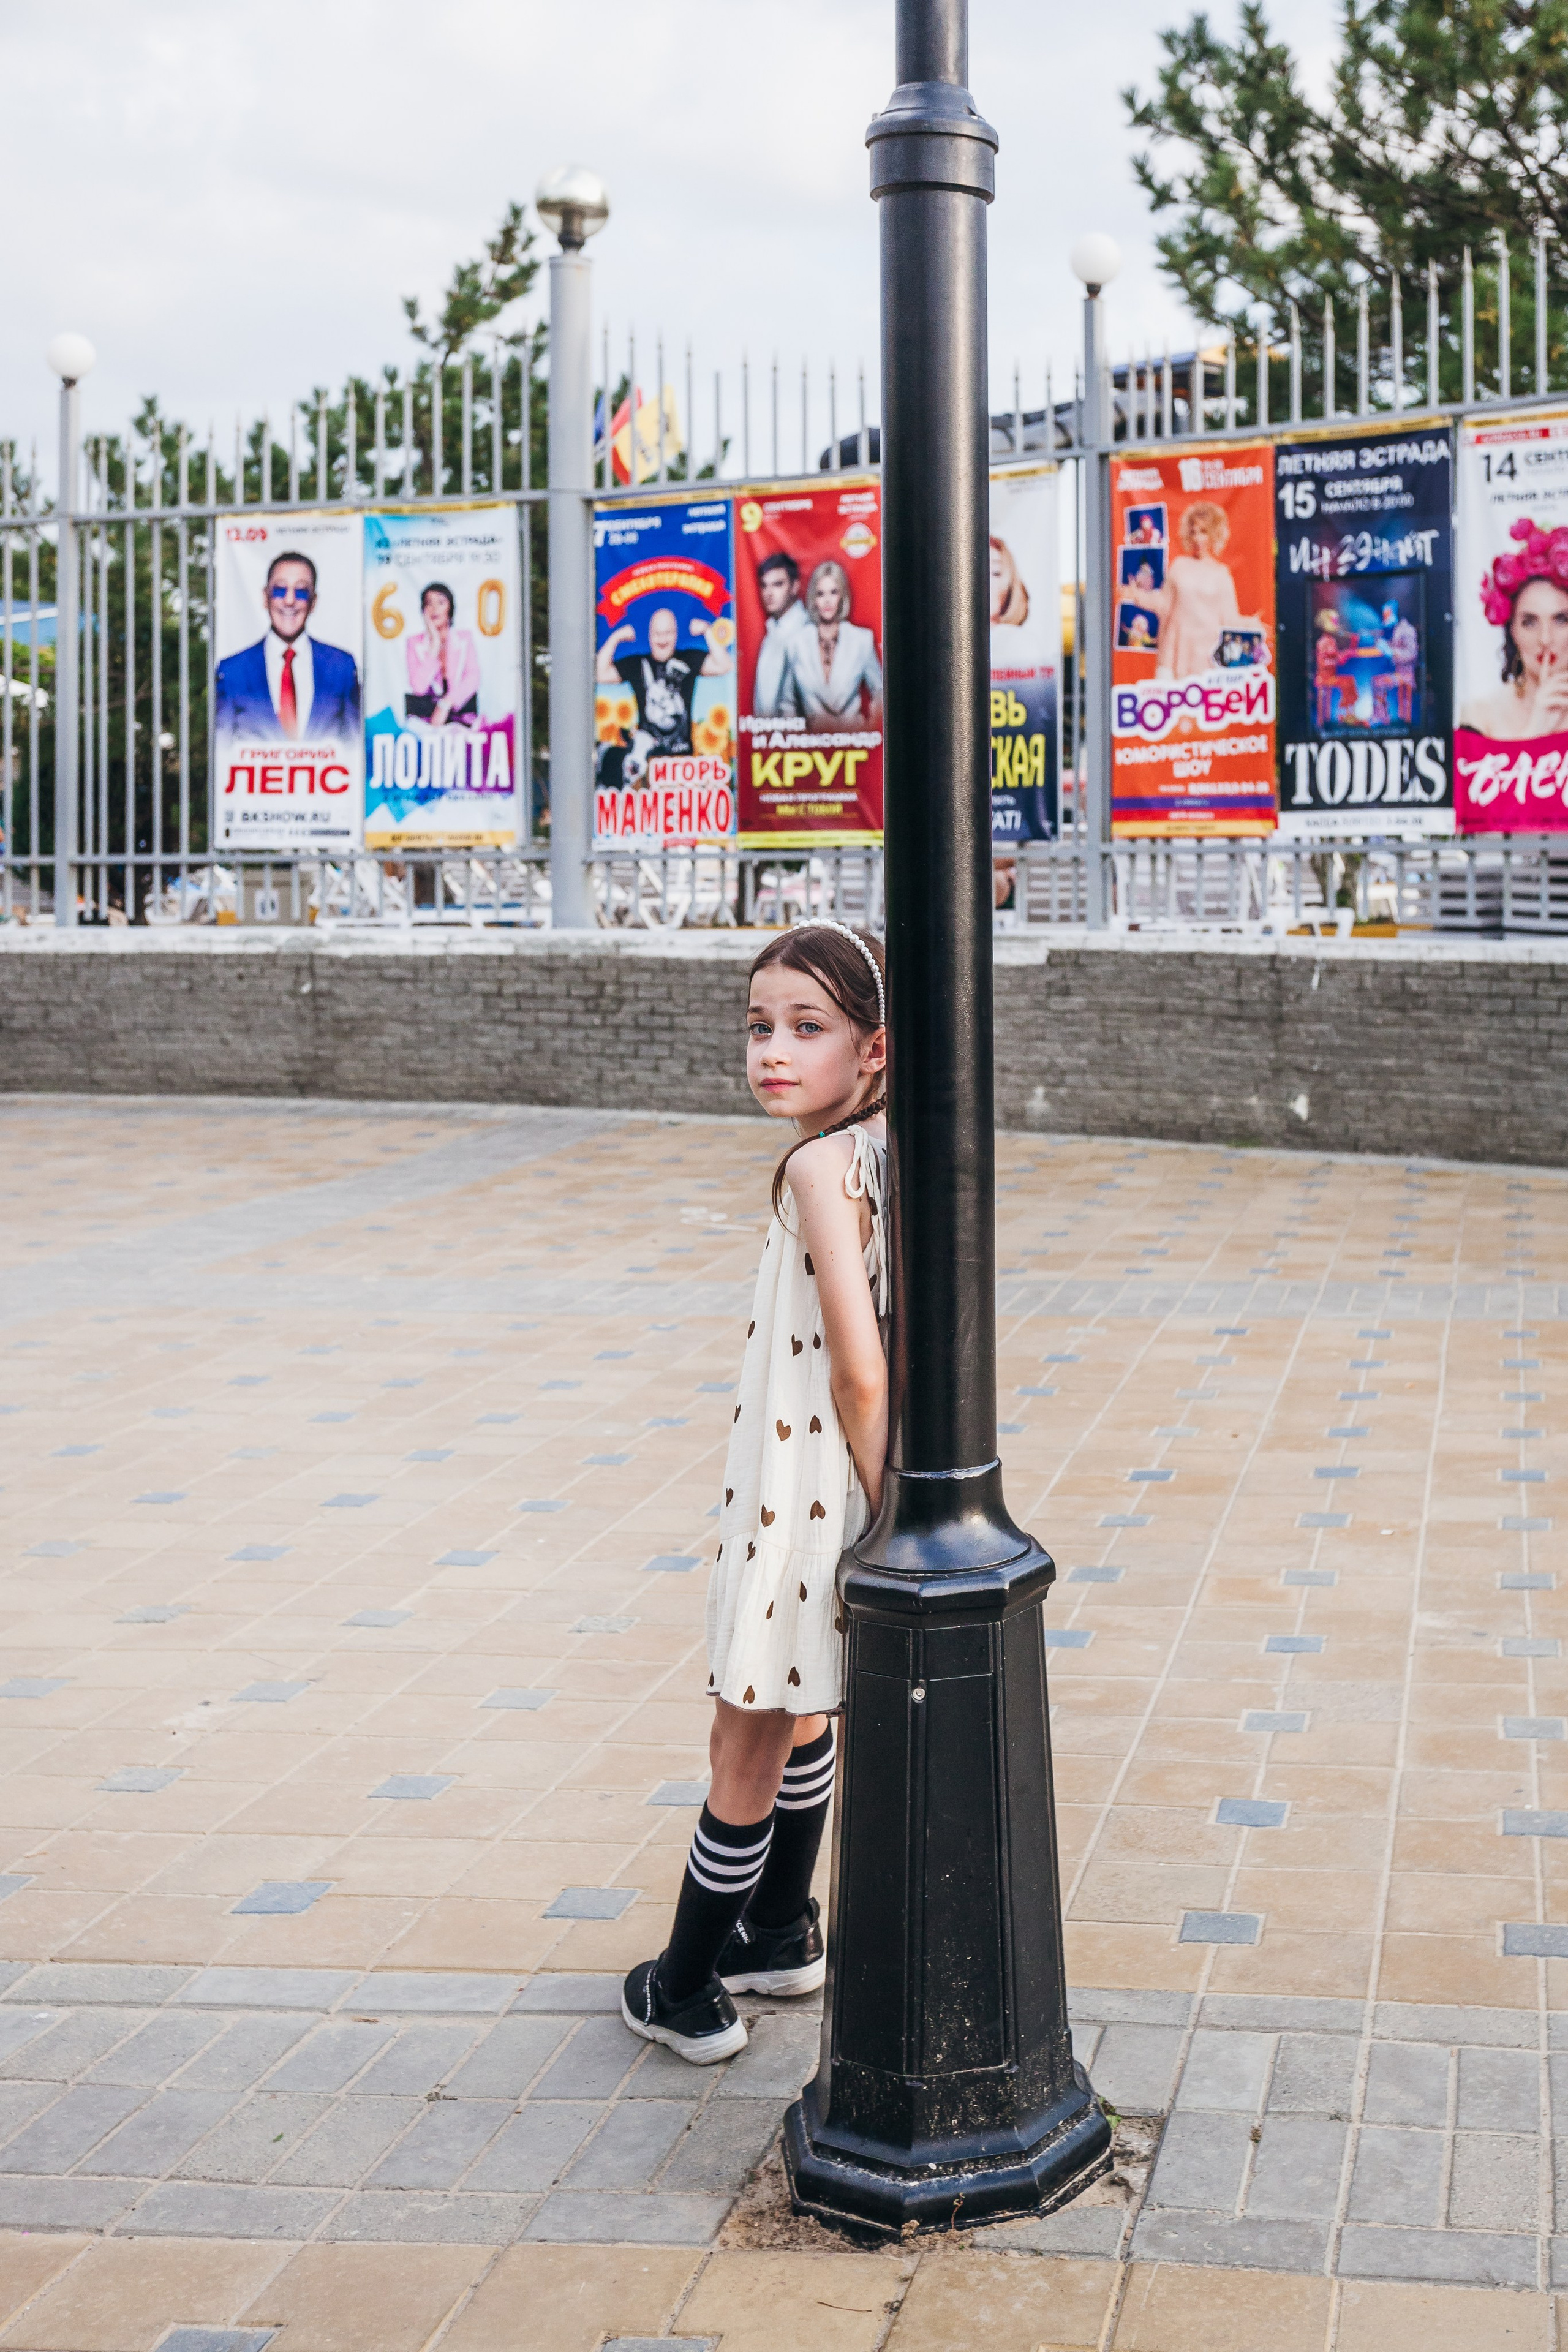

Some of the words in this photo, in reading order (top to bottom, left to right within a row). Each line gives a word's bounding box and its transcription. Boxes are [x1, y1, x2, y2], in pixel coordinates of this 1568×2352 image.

[1277, 450, 1356, 475] ЛЕТНЯЯ
[1359, 439, 1451, 469] ЭСТРАДА
[1483, 452, 1517, 483] 14
[1524, 449, 1568, 466] СЕНТ
[1278, 480, 1316, 519] 15
[1324, 475, 1403, 498] СЕНТЯБРЯ
[740, 502, 763, 532] 9
[372, 582, 404, 639] 6
[478, 579, 505, 637] 0
[991, 690, 1027, 728] ВЬ
[241, 745, 336, 760] ГРИГОРИЙ
[369, 731, 511, 790] ЛОЛИТА
[1115, 734, 1268, 765] ЮМОРИСТИЧЕСКОЕ
[225, 765, 350, 793] ЛЕПС
[655, 761, 726, 782] ИГОРЬ
[752, 750, 869, 788] КРУГ
[1173, 759, 1212, 778] ШОУ
[1285, 737, 1447, 805] TODES
[598, 789, 730, 837] МАМЕНКО
